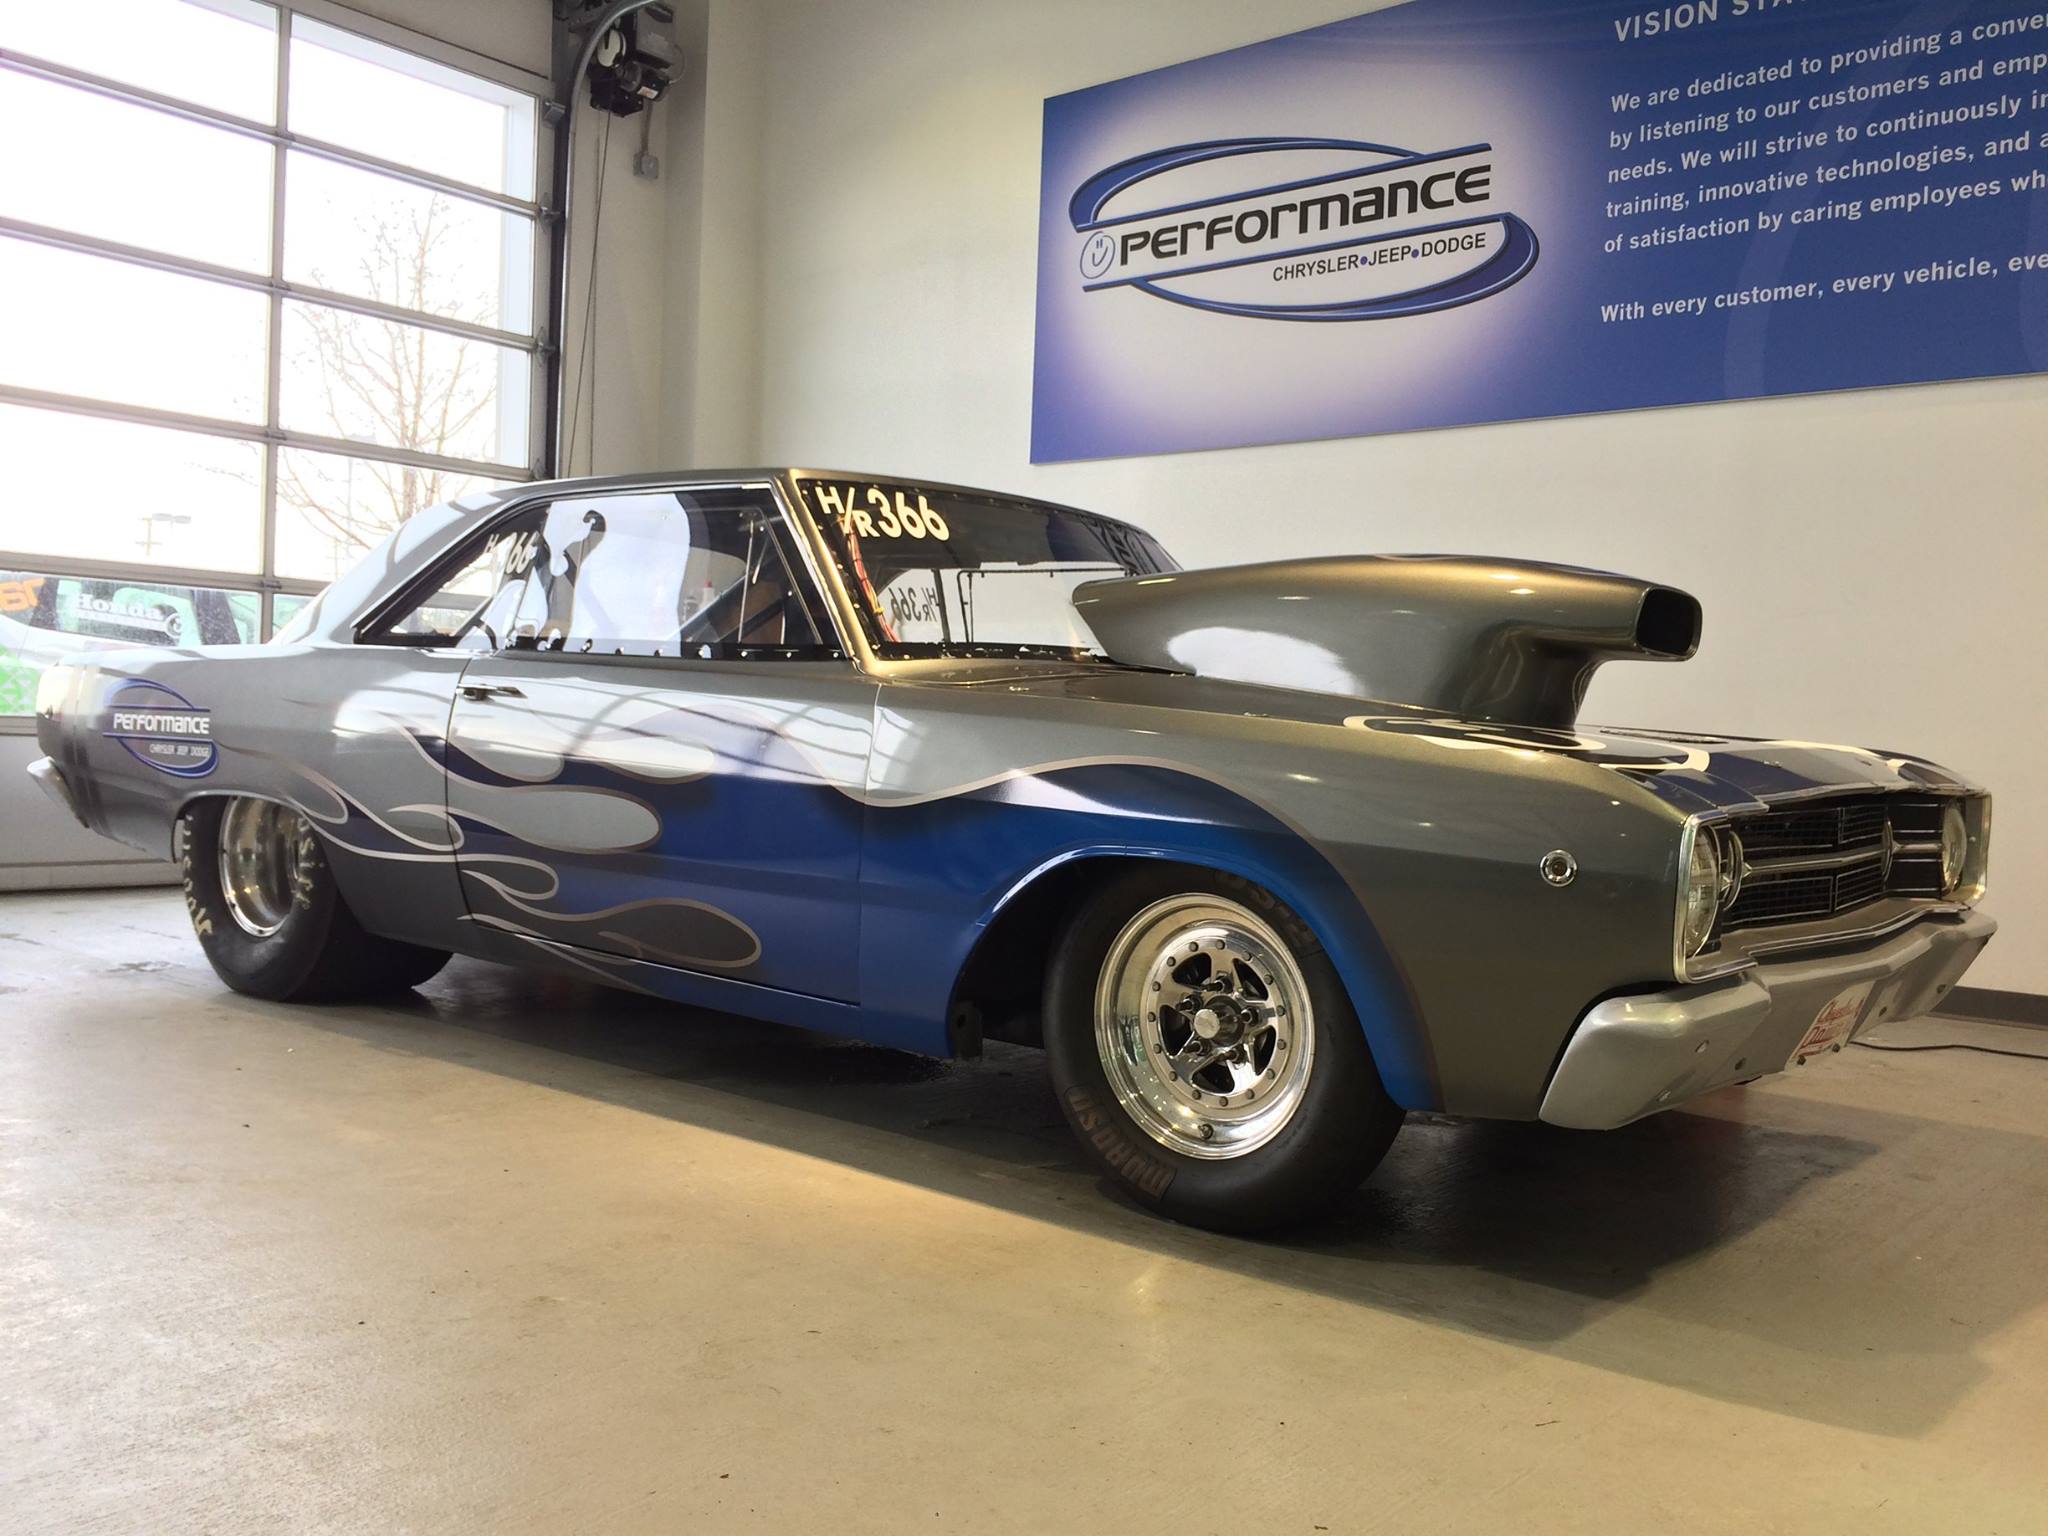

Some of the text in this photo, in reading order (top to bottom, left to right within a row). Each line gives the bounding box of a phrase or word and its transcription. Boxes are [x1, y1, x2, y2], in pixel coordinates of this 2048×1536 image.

[1610, 11, 2048, 113] We are dedicated to providing a conve
[1614, 0, 1718, 42] VISION
[1609, 161, 1673, 184] needs.
[1681, 151, 1712, 169] We
[1720, 142, 1757, 163] will
[1766, 129, 1828, 155] strive
[1836, 125, 1857, 143] to
[1866, 94, 2021, 137] continuously
[1610, 131, 1632, 150] by
[1640, 111, 1729, 143] listening
[1736, 106, 1756, 124] to
[1765, 100, 1800, 119] our
[1809, 75, 1930, 110] customers
[1939, 61, 1983, 84] and
[1604, 168, 2048, 253] of satisfaction by caring employees wh
[1606, 191, 1690, 218] training,
[1699, 169, 1808, 202] innovative
[1816, 144, 1974, 184] technologies,
[1984, 131, 2030, 156] and
[1272, 232, 1487, 281] CHRYSLER JEEP DODGE
[1601, 305, 1644, 323] With
[1652, 296, 1707, 317] every
[1714, 280, 1824, 307] customer,
[1832, 271, 1894, 295] every
[1904, 257, 1998, 284] vehicle,
[867, 488, 950, 541] 366
